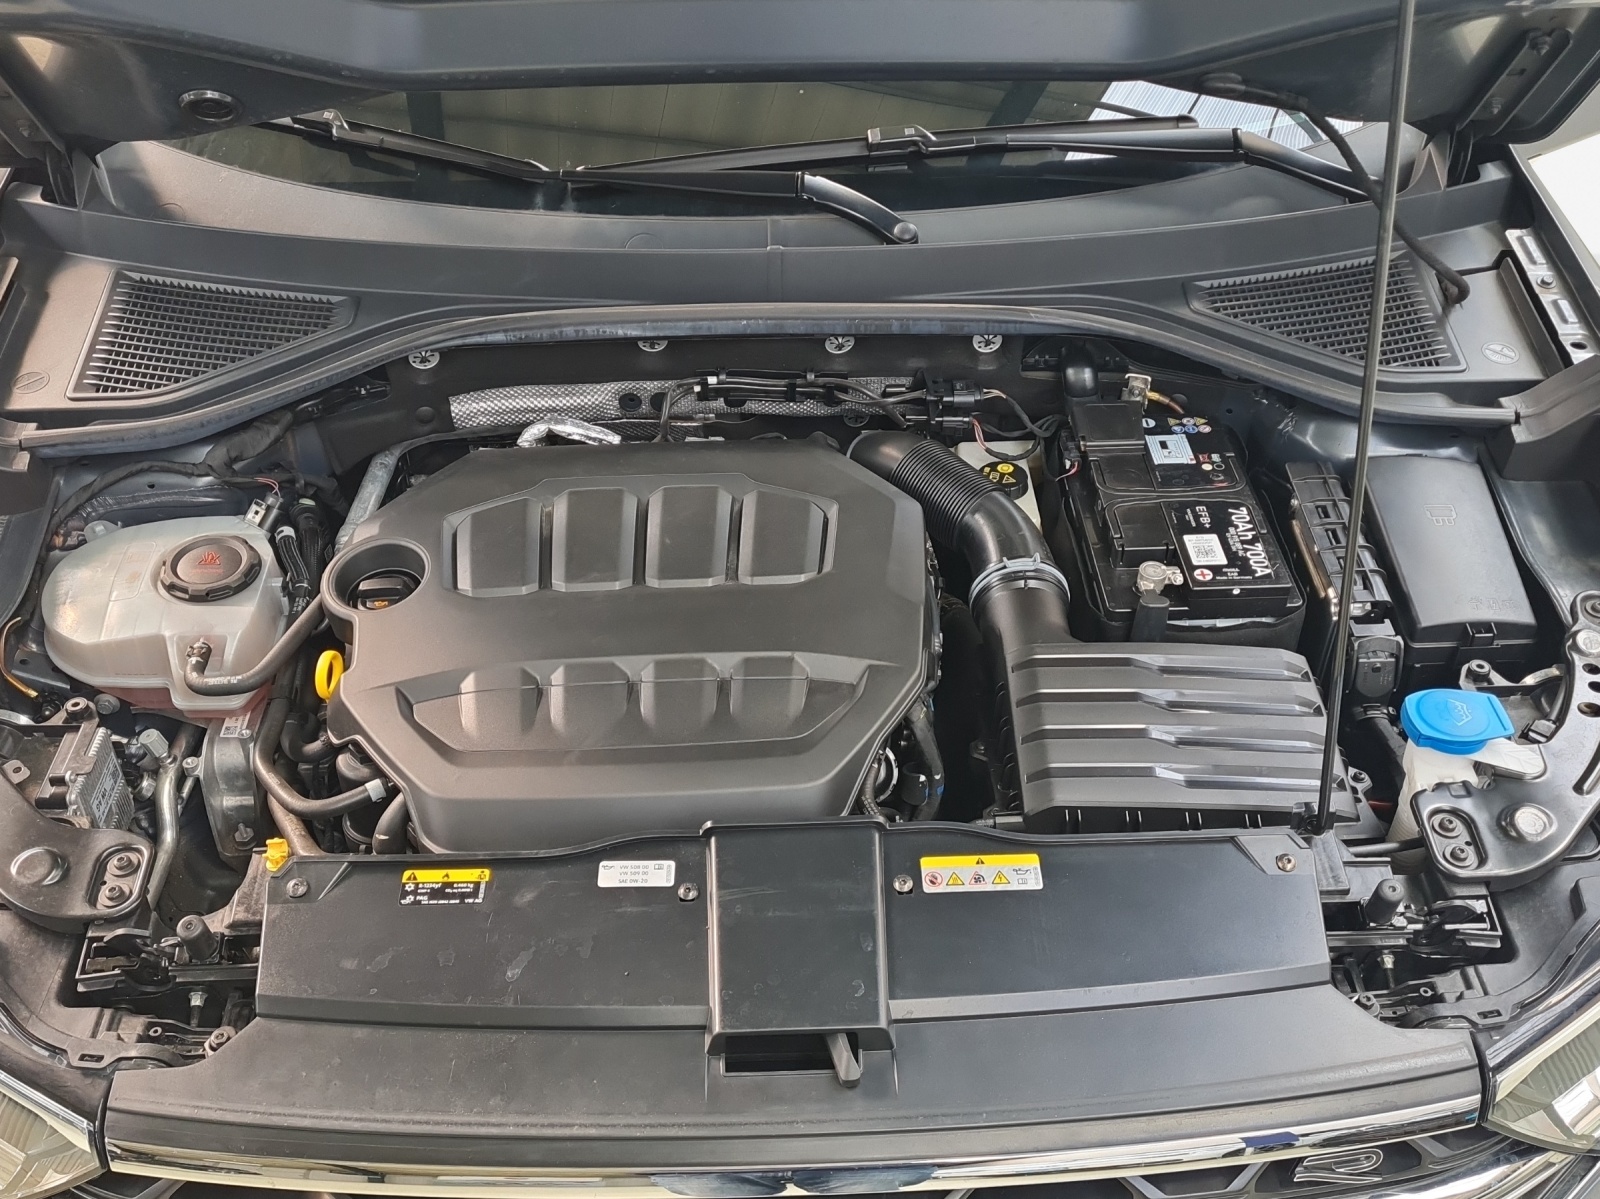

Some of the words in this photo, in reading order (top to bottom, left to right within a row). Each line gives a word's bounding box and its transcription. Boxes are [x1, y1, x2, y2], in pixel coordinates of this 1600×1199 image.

[1196, 506, 1211, 528] EFB+
[1228, 506, 1256, 540] 70Ah
[1243, 543, 1272, 577] 700A
